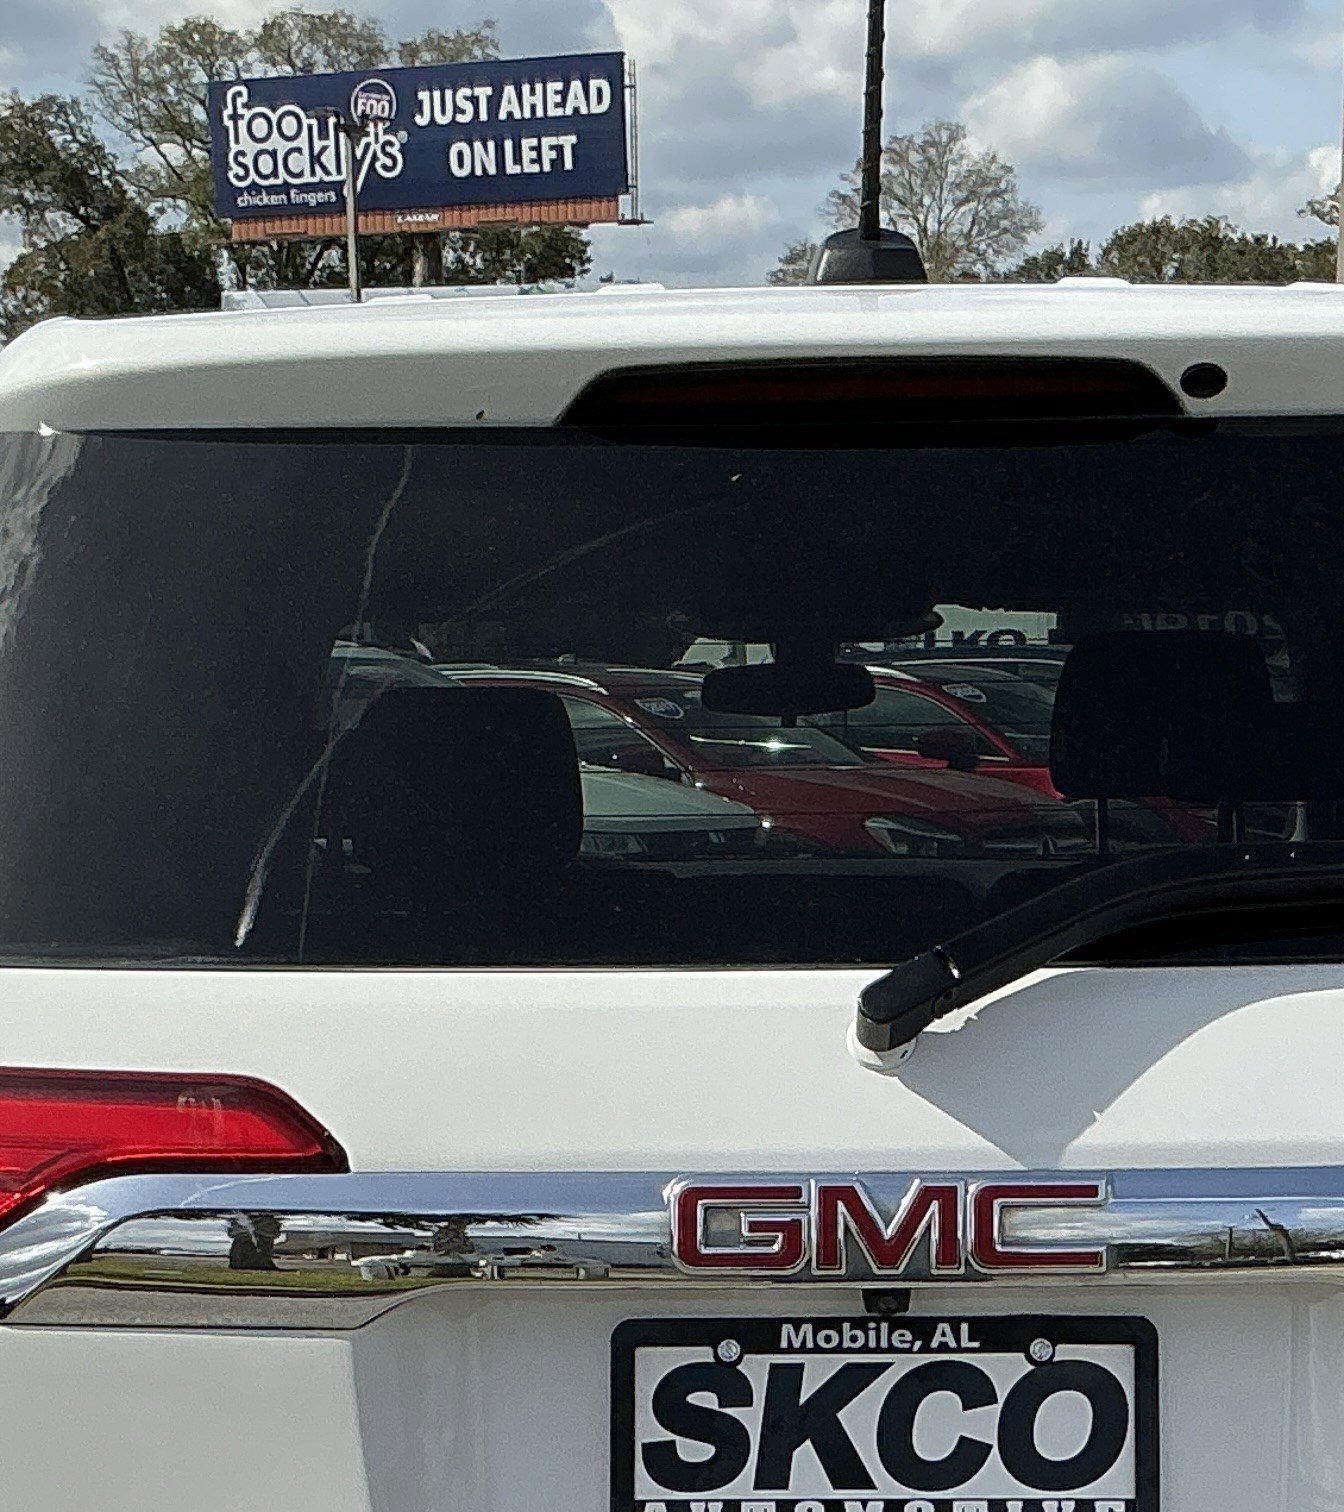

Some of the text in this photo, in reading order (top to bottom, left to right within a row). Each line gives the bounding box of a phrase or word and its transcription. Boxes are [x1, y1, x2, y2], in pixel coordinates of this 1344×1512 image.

[226, 90, 304, 146] foo
[415, 79, 611, 127] JUST AHEAD
[450, 135, 577, 178] ON LEFT
[237, 188, 337, 207] chicken fingers
[664, 1178, 1111, 1276] GMC
[779, 1322, 981, 1352] Mobile, AL
[640, 1359, 1130, 1493] SKCO
